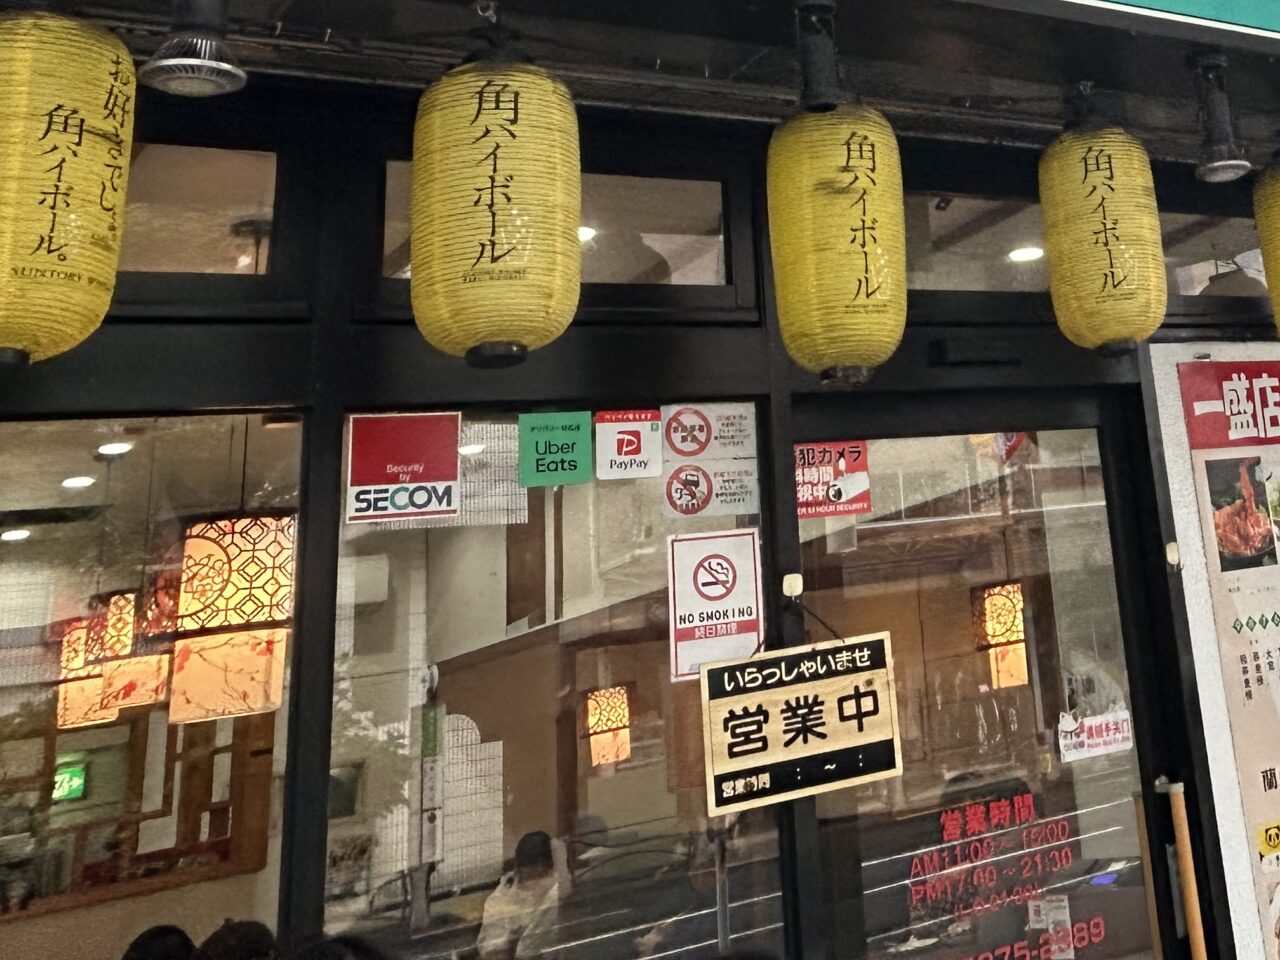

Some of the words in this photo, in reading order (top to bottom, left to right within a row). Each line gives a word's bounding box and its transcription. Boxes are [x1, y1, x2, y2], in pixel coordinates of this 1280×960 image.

[469, 80, 520, 271] 角ハイボール
[842, 131, 881, 302] 角ハイボール
[1081, 146, 1128, 294] 角ハイボール
[535, 440, 576, 455] Uber
[536, 457, 578, 473] Eats
[610, 459, 649, 470] PayPay
[796, 446, 861, 465] 犯カメラ
[354, 485, 452, 513] SECOM
[679, 613, 694, 625] NO
[699, 606, 753, 622] SMOKING
[723, 647, 871, 691] いらっしゃいませ
[723, 685, 880, 759] 営業中
[940, 794, 1035, 841] 営業時間
